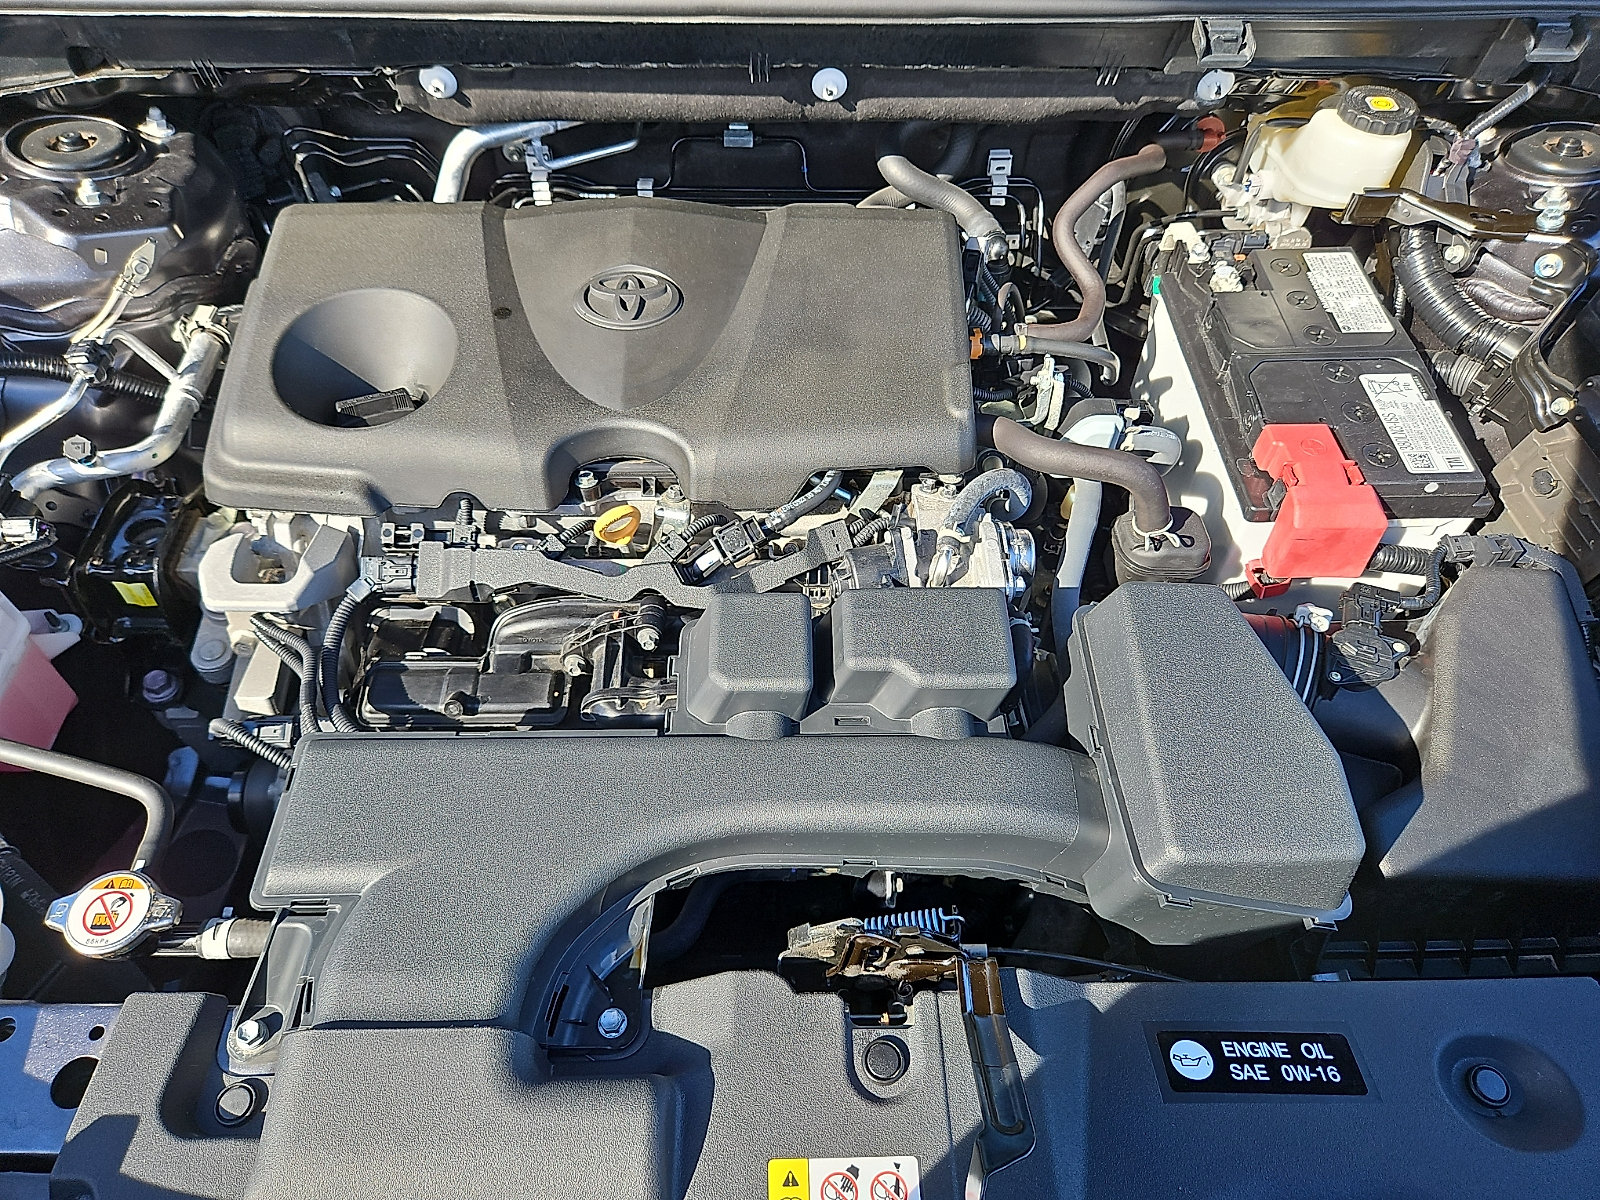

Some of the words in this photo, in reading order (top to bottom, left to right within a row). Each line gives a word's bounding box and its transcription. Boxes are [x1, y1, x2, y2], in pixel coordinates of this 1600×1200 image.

[1220, 1041, 1291, 1058] ENGINE
[1301, 1042, 1334, 1060] OIL
[1229, 1063, 1270, 1081] SAE
[1281, 1064, 1341, 1083] 0W-16
